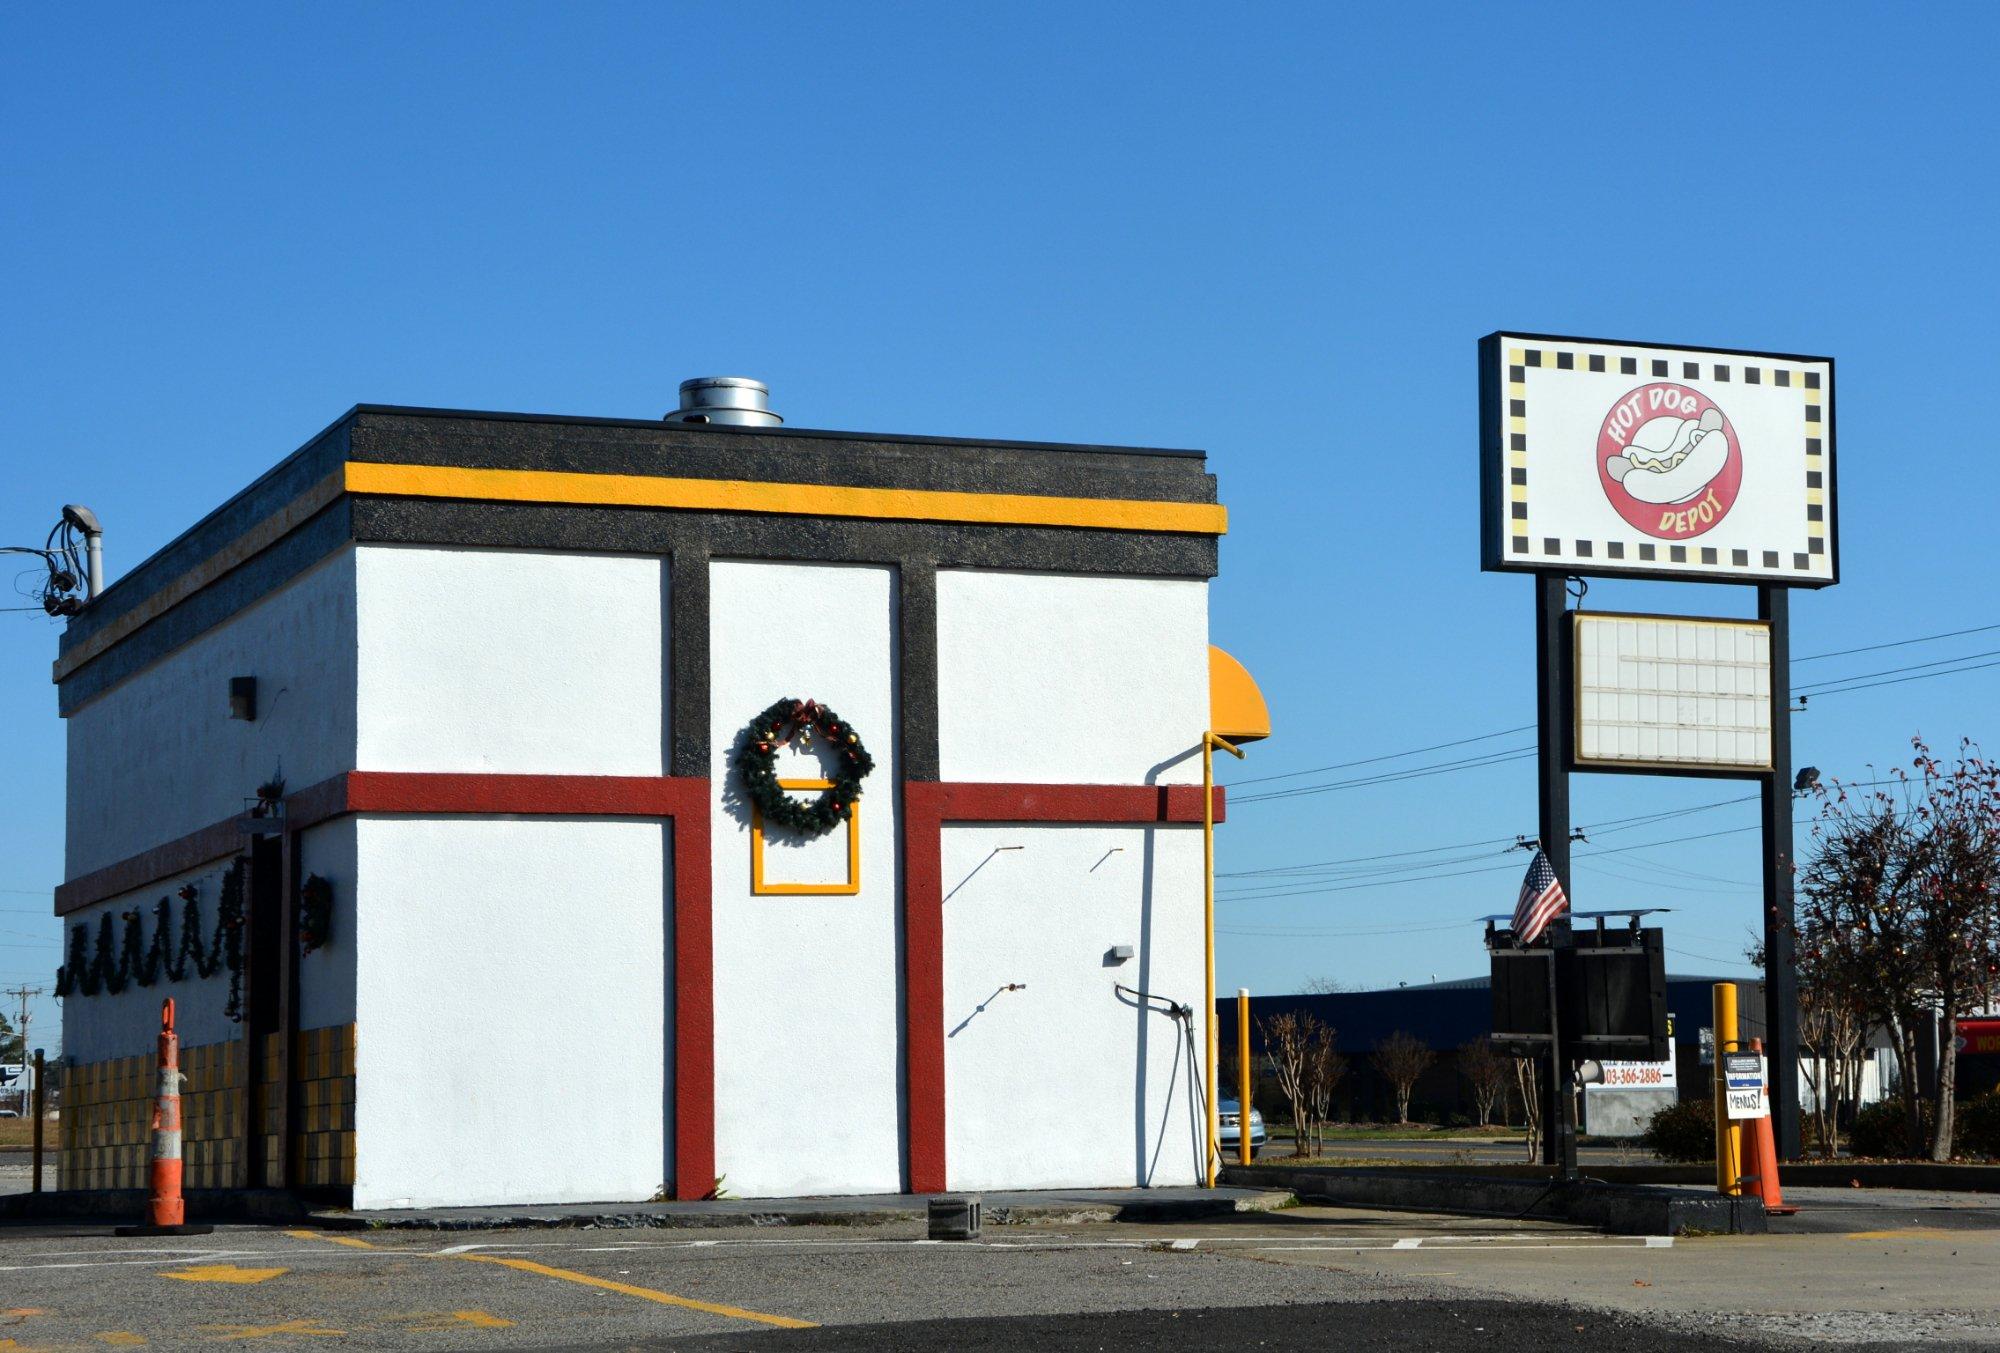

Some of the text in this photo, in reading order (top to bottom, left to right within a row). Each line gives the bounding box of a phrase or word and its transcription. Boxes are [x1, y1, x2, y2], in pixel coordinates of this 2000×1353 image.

[1607, 388, 1697, 446] HOT DOG
[1659, 488, 1723, 533] DEPOT
[1604, 1068, 1661, 1084] 03-366-2886
[1729, 1090, 1761, 1110] MENUS!
